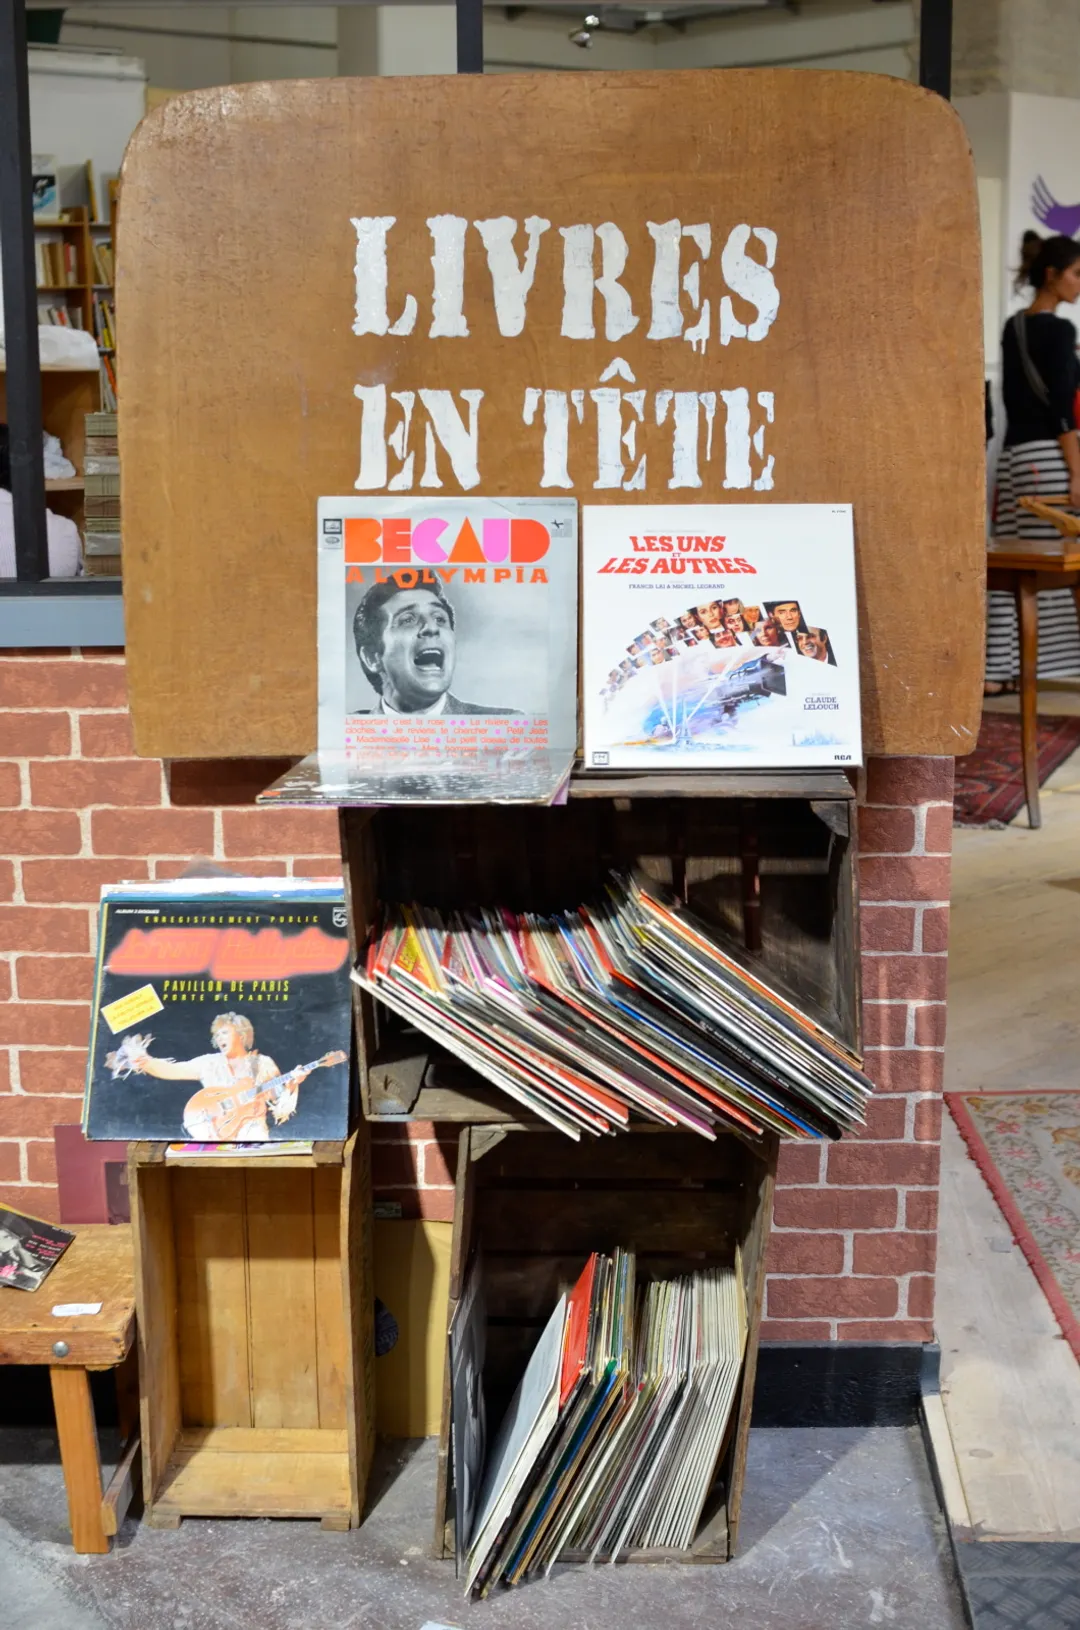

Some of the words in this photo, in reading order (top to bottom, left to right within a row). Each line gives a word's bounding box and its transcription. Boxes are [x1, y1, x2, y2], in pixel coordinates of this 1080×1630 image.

[350, 213, 781, 354] LIVRES
[354, 383, 484, 491] EN
[522, 357, 775, 491] TÊTE
[345, 516, 550, 563] BECAUD
[629, 536, 675, 552] LES
[676, 536, 726, 552] UNS
[597, 558, 649, 574] LES
[650, 558, 757, 574] AUTRES
[163, 980, 223, 992] PAVILLON
[231, 980, 243, 992] DE
[253, 980, 289, 992] PARIS
